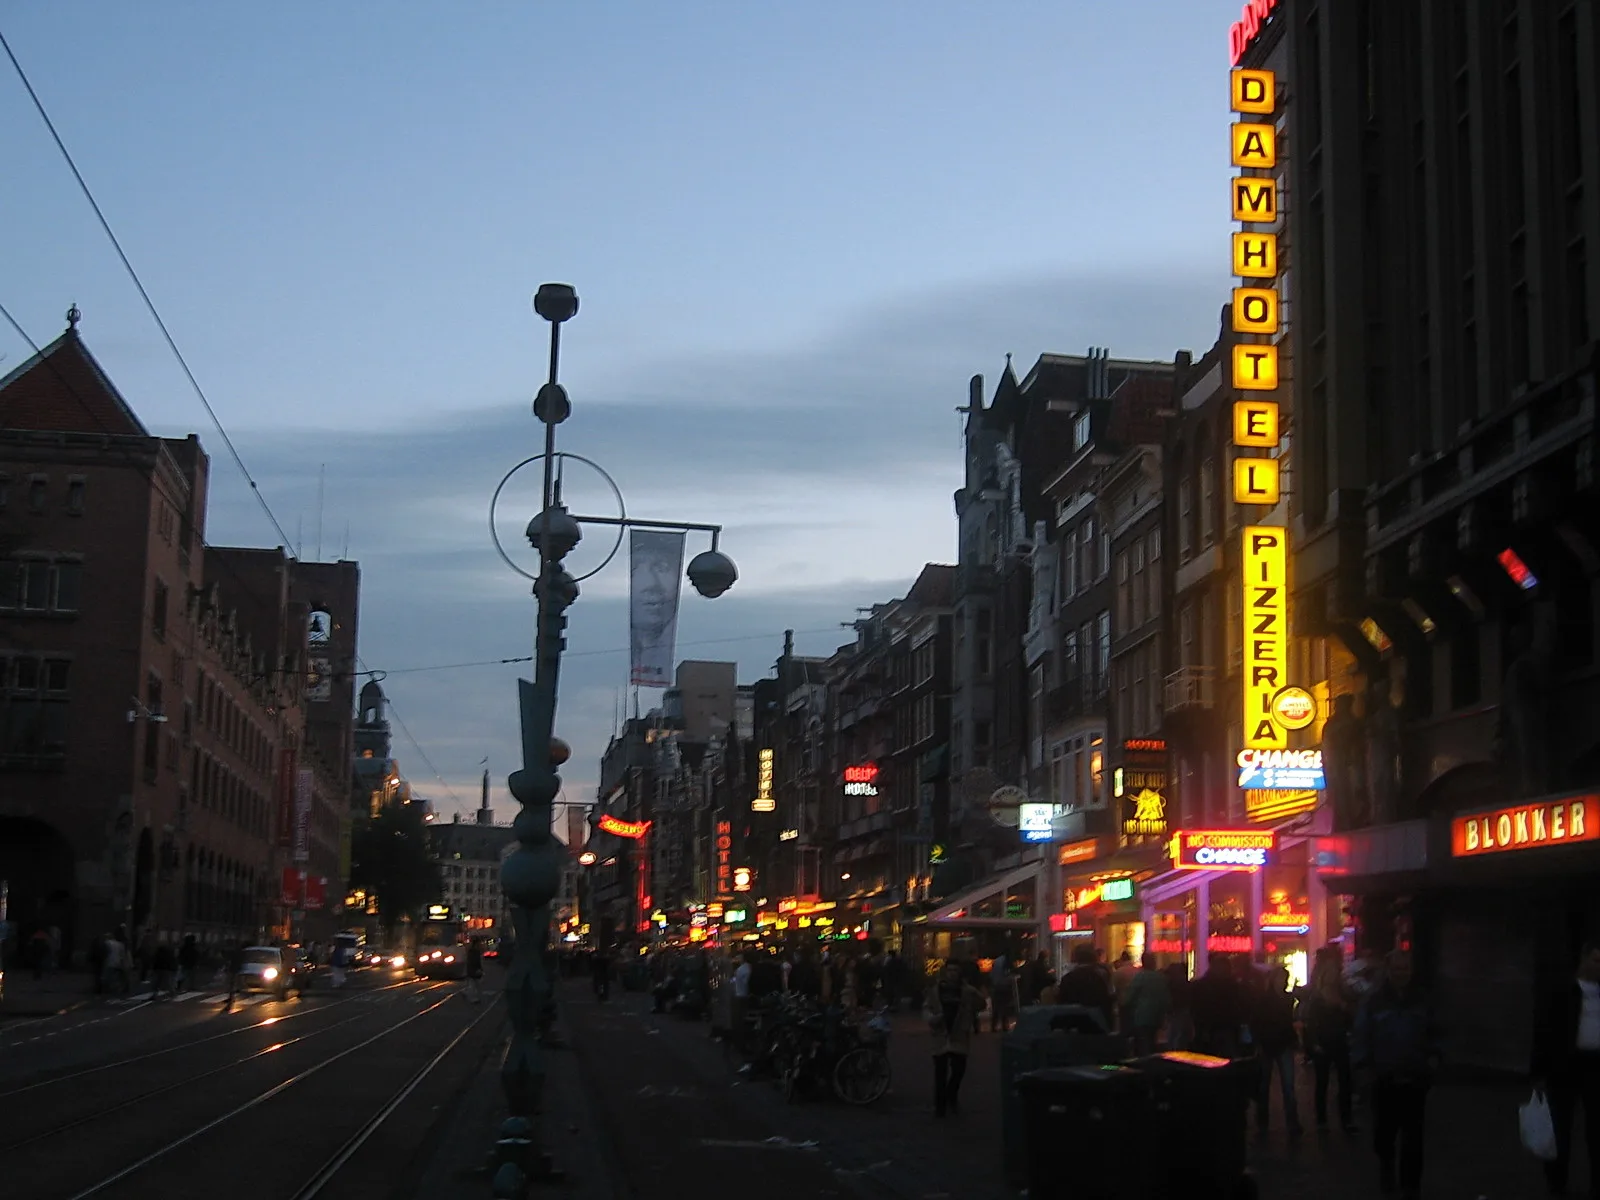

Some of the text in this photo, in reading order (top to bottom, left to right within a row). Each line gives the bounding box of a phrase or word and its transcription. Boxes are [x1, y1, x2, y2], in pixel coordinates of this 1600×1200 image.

[1229, 0, 1275, 67] DAM
[1252, 535, 1278, 741] PIZZERIA
[1124, 740, 1166, 751] HOTEL
[1237, 749, 1323, 769] CHANGE
[758, 749, 773, 799] HOTEL
[845, 783, 878, 796] HOTEL
[1187, 835, 1273, 848] NO COMMISSION
[1465, 802, 1585, 851] BLOKKER
[717, 821, 731, 893] HOTEL
[1195, 848, 1266, 865] CHANGE
